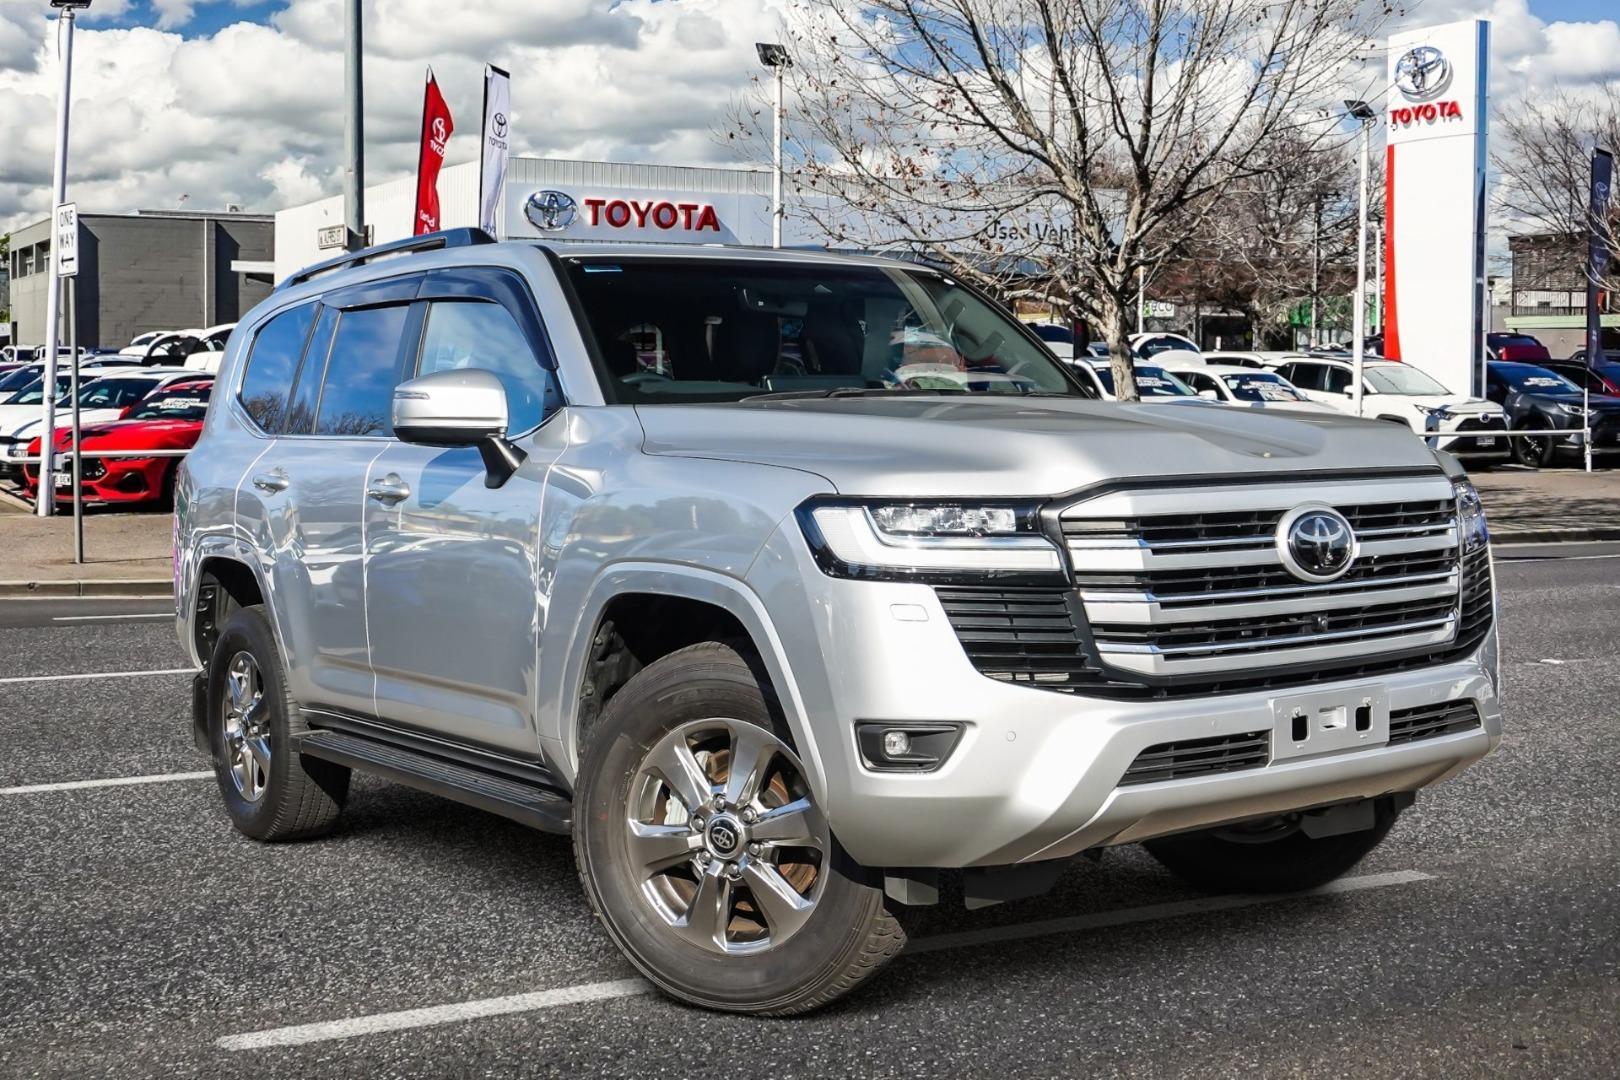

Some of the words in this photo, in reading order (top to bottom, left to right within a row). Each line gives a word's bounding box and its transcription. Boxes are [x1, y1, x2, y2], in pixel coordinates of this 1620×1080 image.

[1389, 100, 1462, 124] TOYOTA
[59, 210, 74, 228] ONE
[584, 198, 721, 232] TOYOTA
[59, 231, 76, 249] WAY
